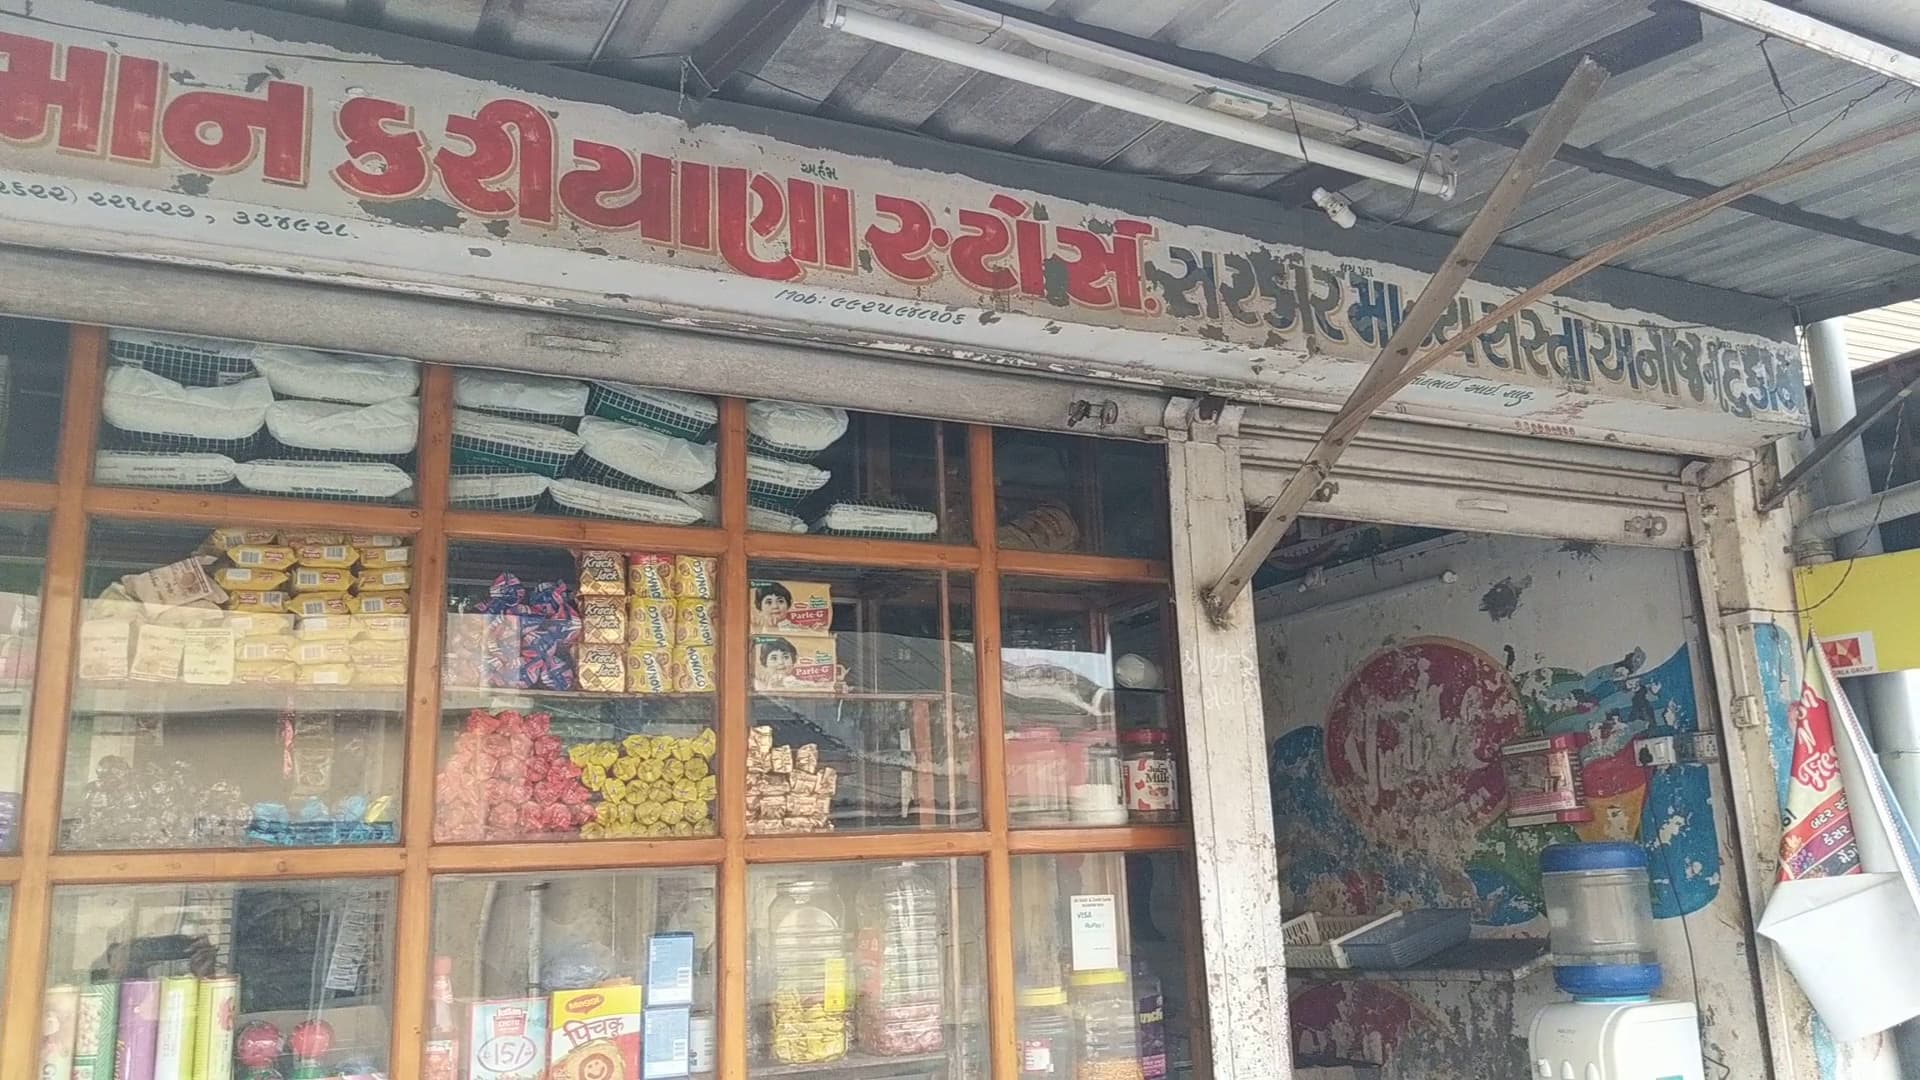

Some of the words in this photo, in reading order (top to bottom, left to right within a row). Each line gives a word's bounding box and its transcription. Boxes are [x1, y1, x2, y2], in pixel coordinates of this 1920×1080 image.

[583, 556, 614, 569] Krack
[595, 569, 620, 581] Jack
[584, 603, 616, 616] Krack
[789, 609, 824, 620] Parle-G
[596, 617, 620, 630] Jack
[584, 650, 617, 663] Krack
[597, 663, 620, 677] Jack
[795, 665, 829, 676] Parle-G
